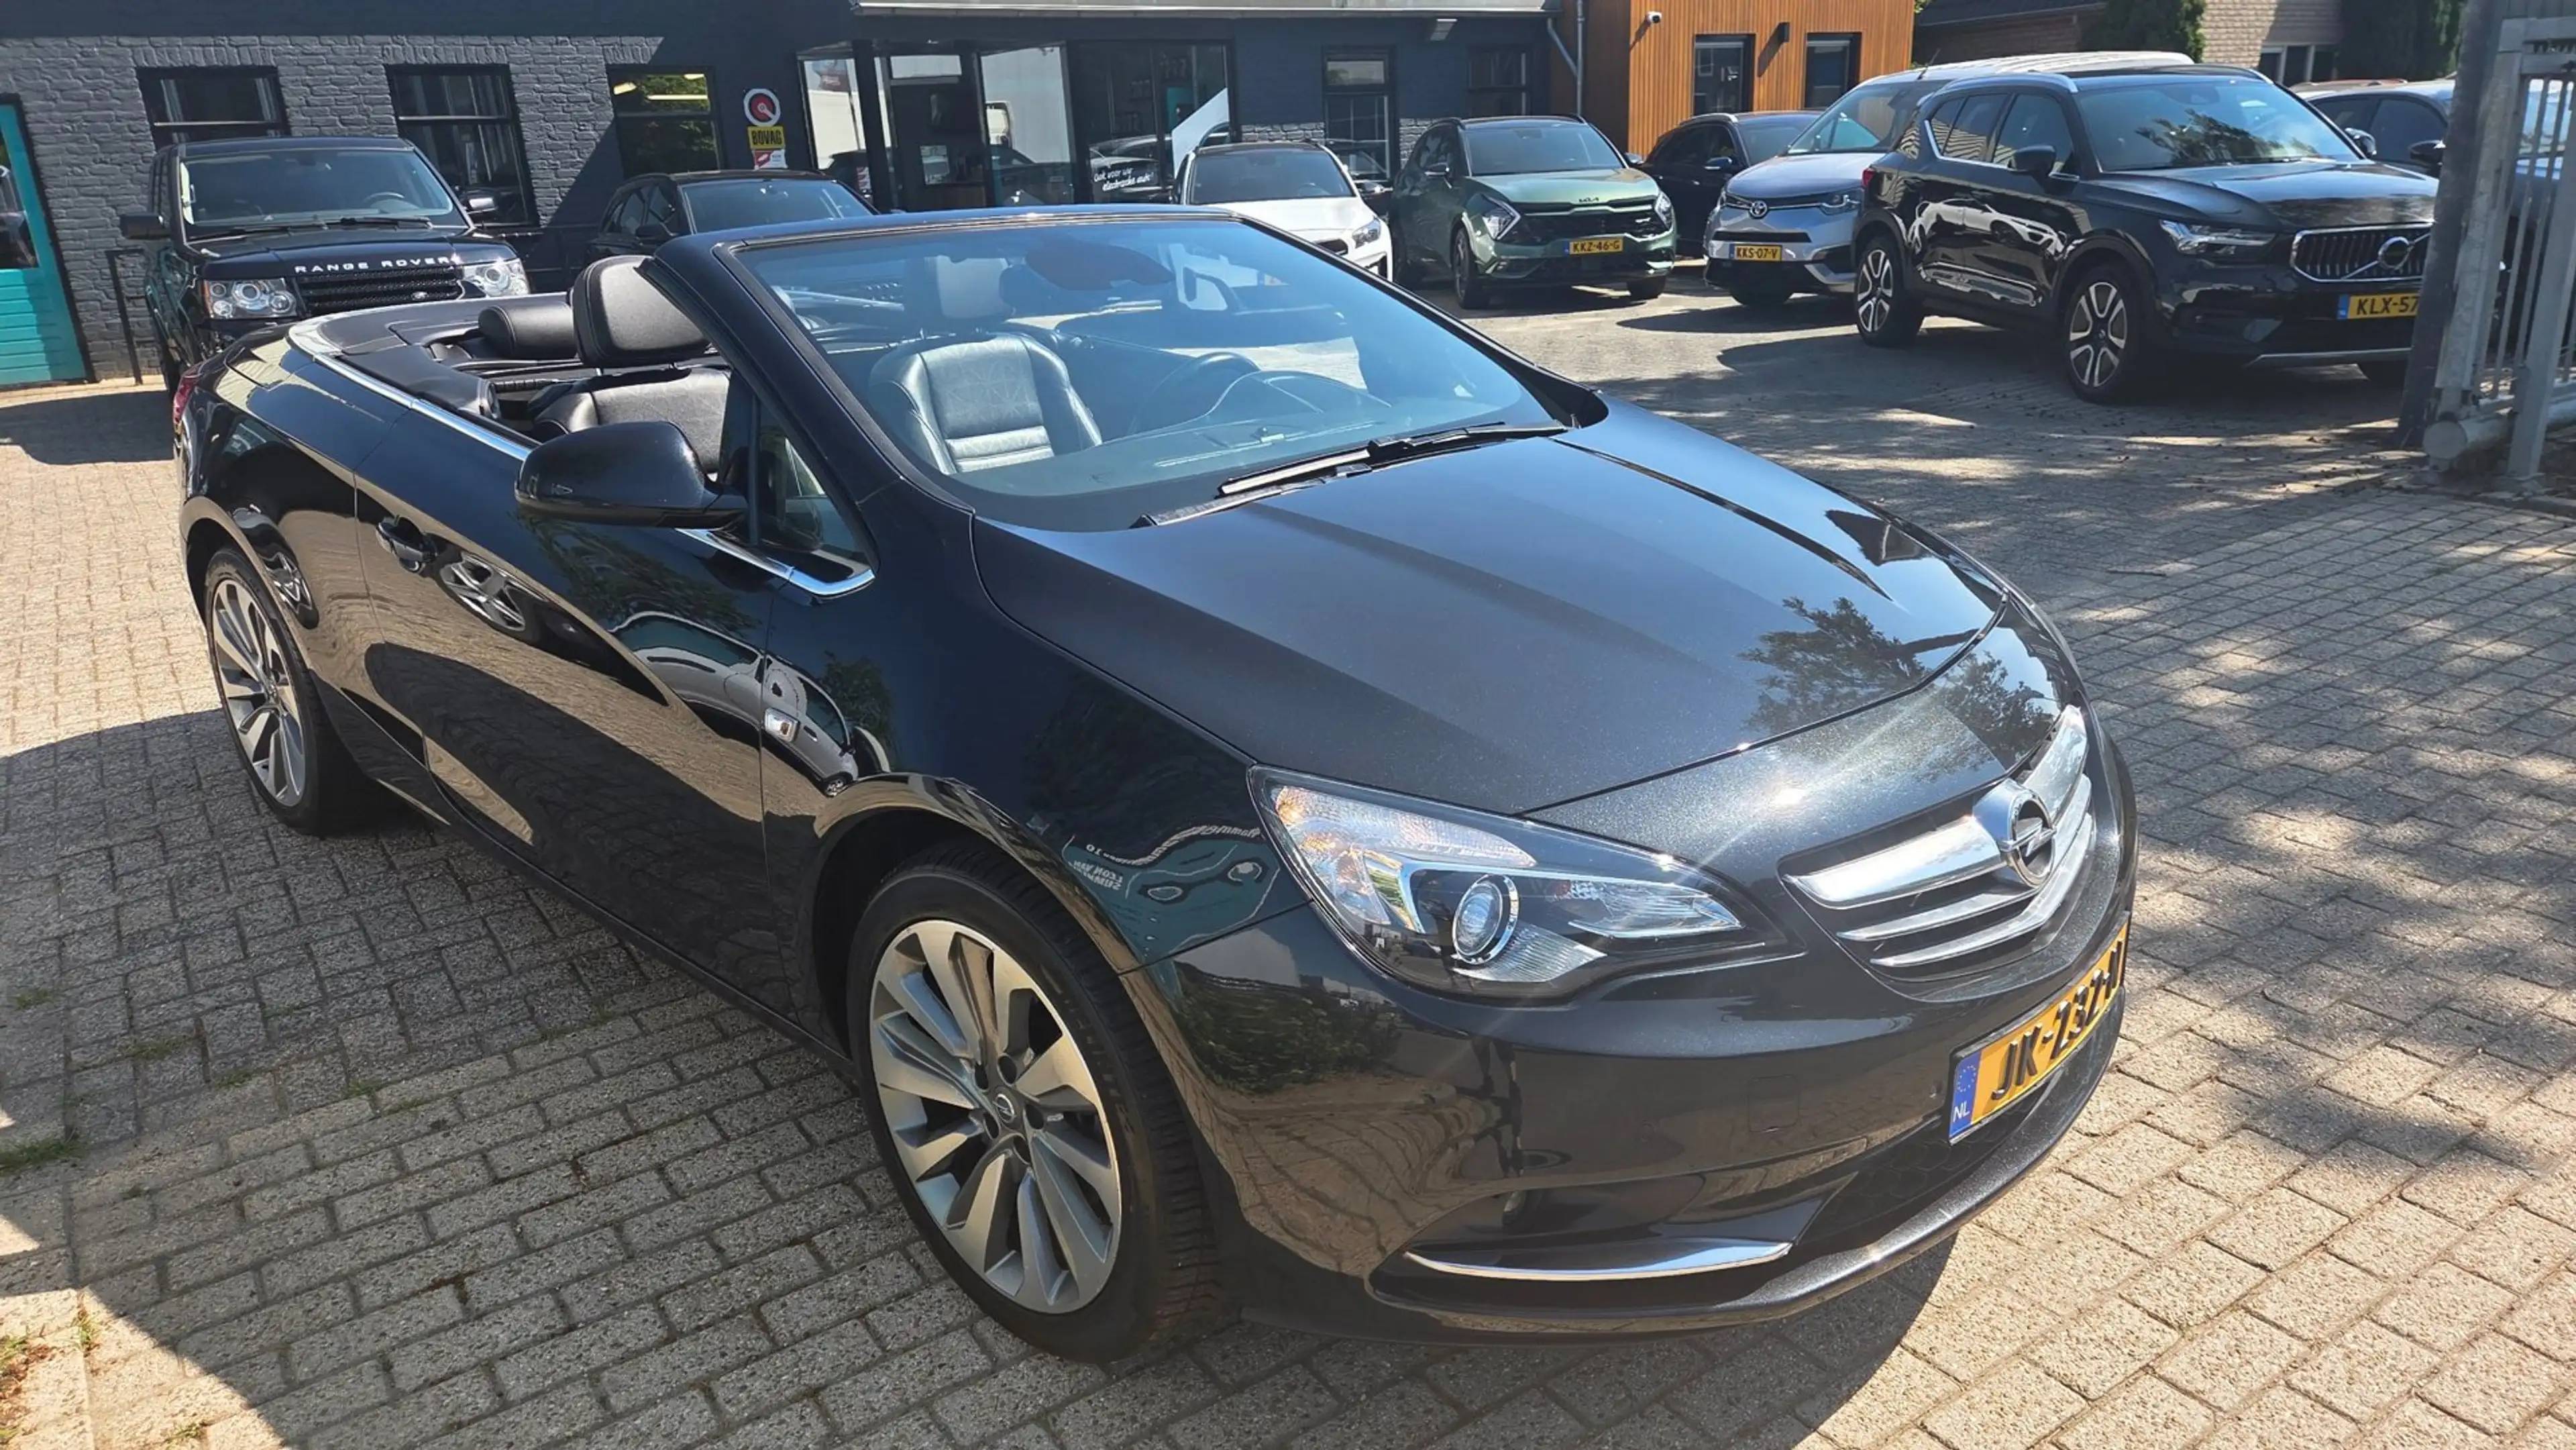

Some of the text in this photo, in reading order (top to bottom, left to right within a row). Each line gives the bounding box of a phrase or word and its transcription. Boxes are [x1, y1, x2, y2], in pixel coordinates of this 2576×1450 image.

[751, 128, 783, 146] BOVAG
[1572, 240, 1620, 252] KKZ-46-G
[1736, 247, 1778, 259] KKS-07-V
[294, 256, 451, 274] RANGE ROVER
[1952, 1101, 1970, 1123] NL
